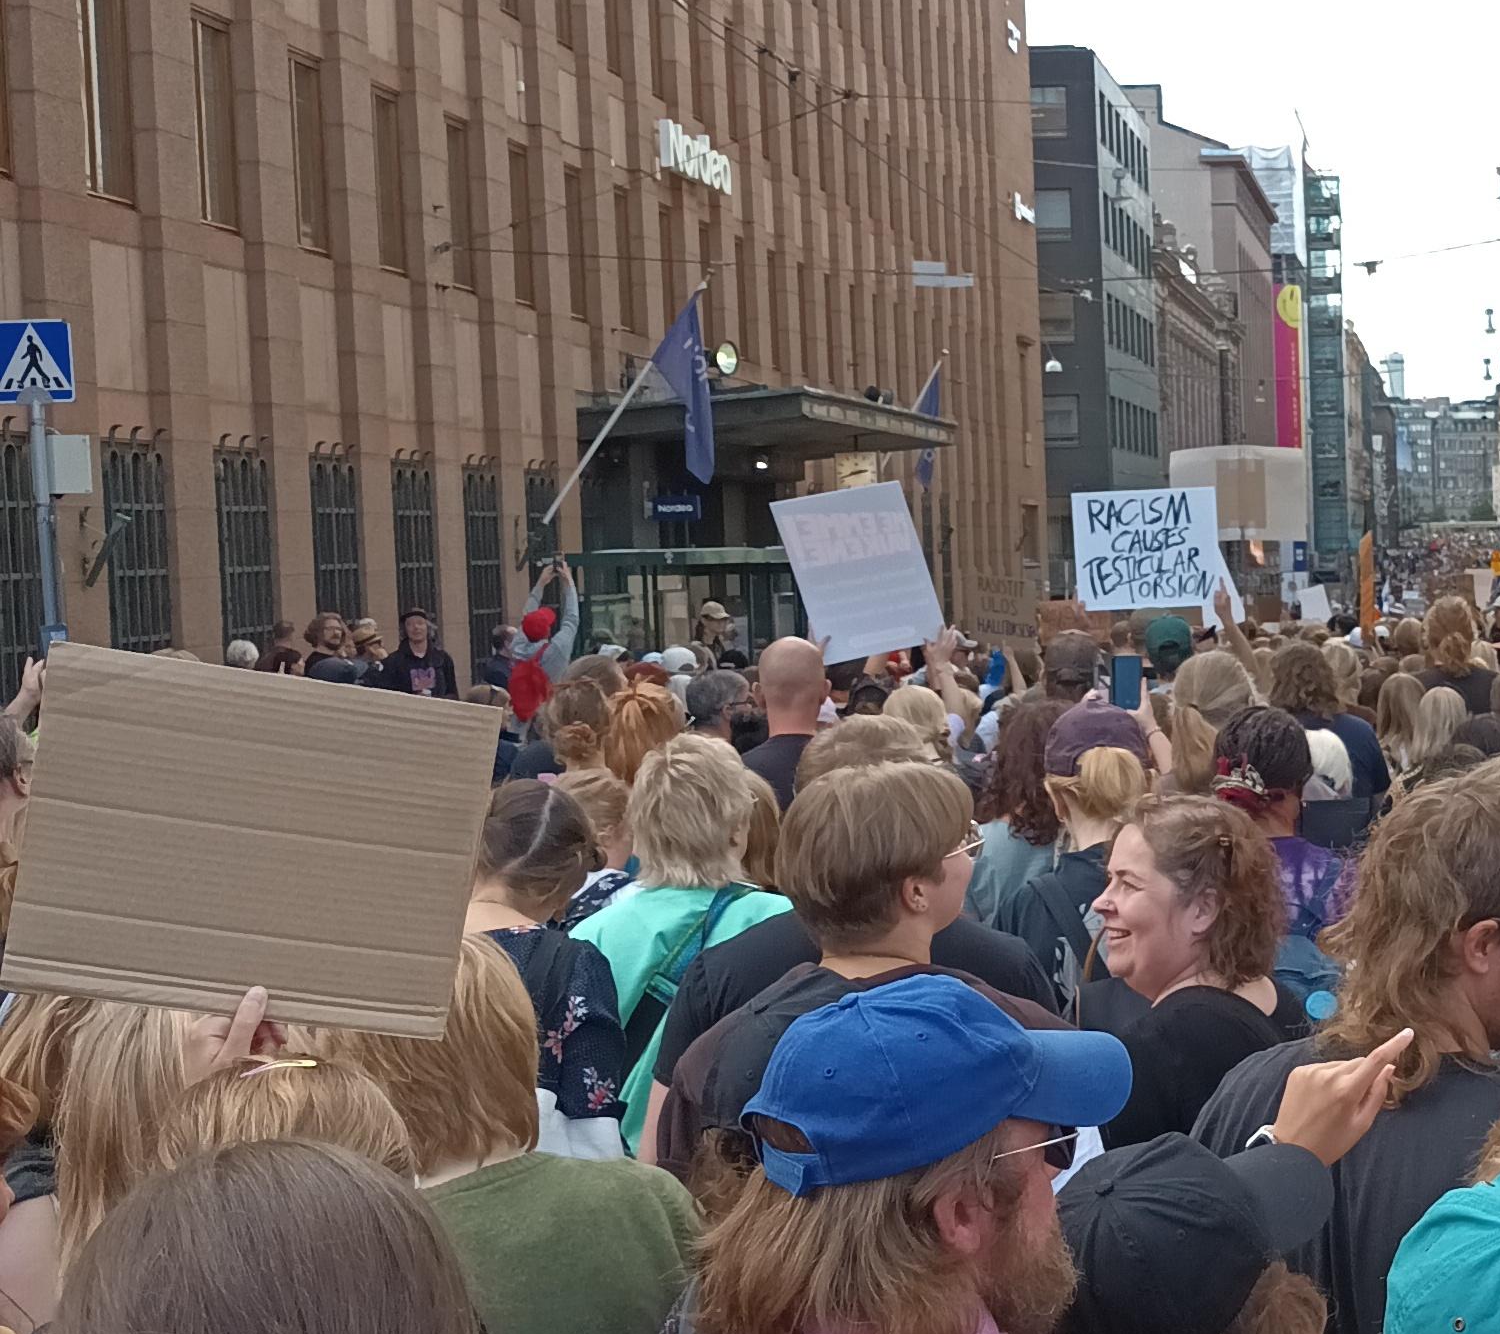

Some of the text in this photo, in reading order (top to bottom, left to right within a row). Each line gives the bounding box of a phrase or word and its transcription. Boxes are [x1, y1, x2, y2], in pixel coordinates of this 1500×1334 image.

[658, 118, 732, 196] Nordea
[657, 504, 694, 513] Nordea
[1088, 492, 1192, 533] RACISM
[1111, 527, 1189, 554] CAUSES
[1083, 547, 1200, 599] TESTICULAR
[1116, 570, 1215, 603] TORSION
[981, 596, 1018, 616] ULOS
